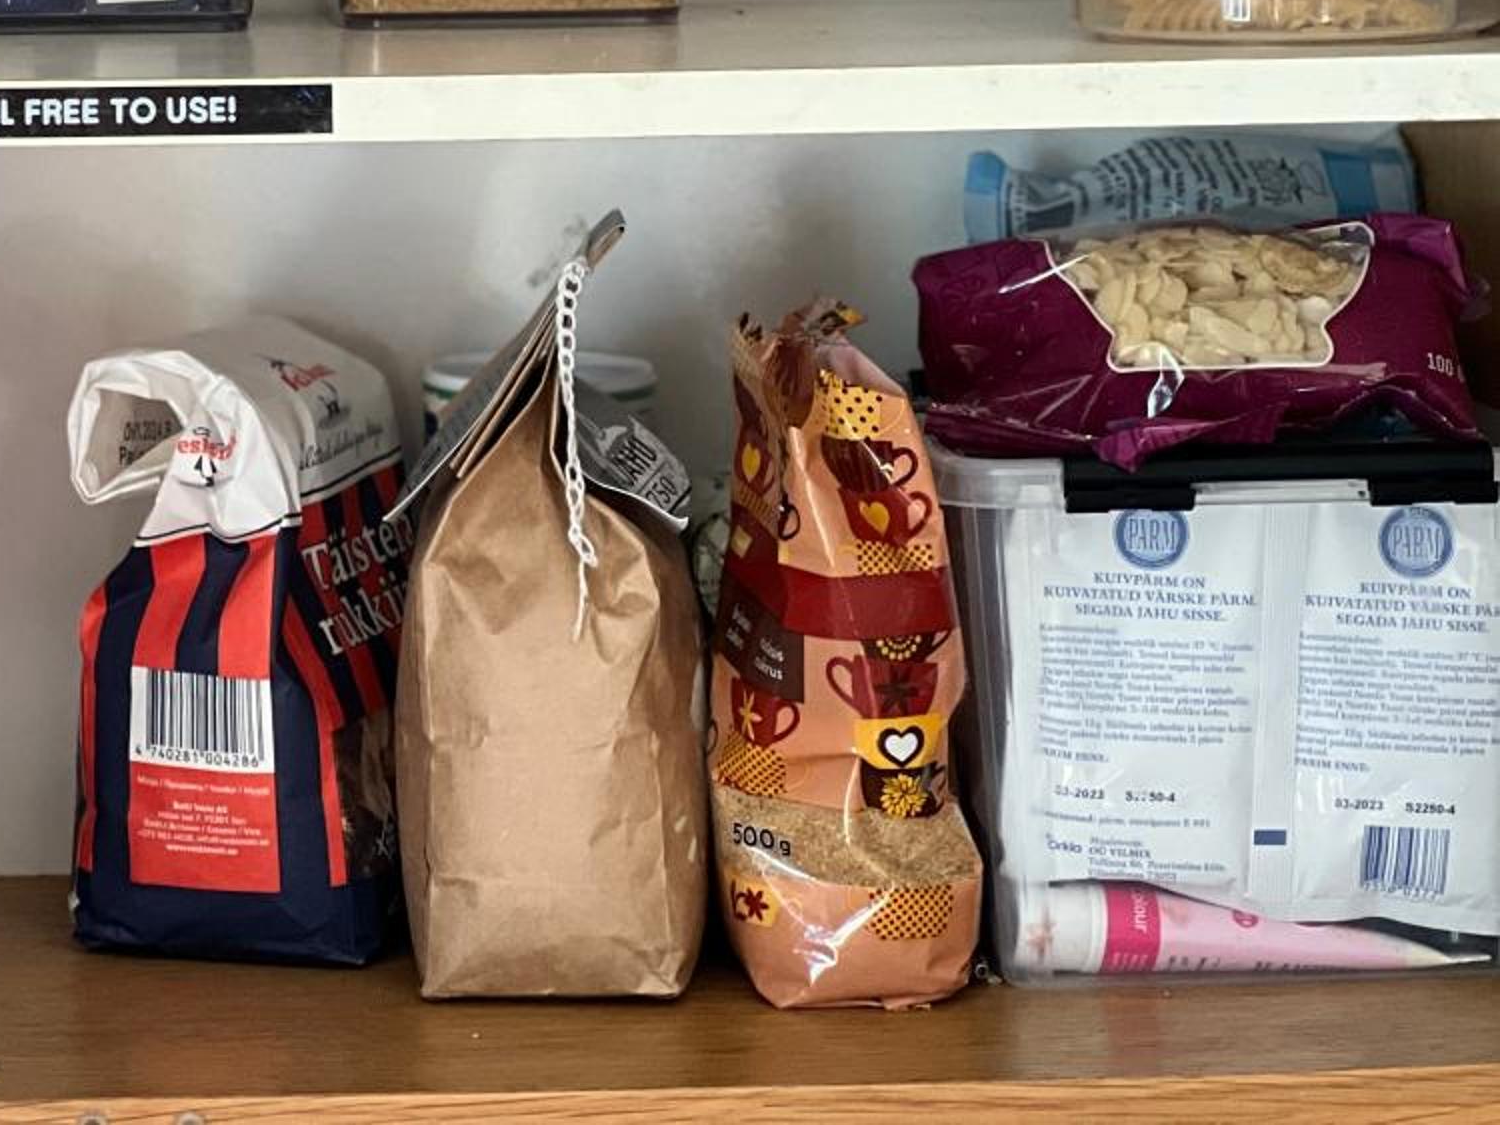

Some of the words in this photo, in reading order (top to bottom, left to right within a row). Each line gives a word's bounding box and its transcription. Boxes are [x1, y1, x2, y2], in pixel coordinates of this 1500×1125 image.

[25, 98, 100, 125] FREE
[110, 98, 157, 124] TO
[167, 96, 237, 123] USE!
[1427, 352, 1453, 376] 100
[1093, 572, 1178, 588] KUIVPÄRM
[1182, 577, 1205, 588] ON
[1044, 586, 1141, 602] KUIVATATUD
[1146, 590, 1207, 606] VÄRSKE
[1447, 586, 1472, 599] ON
[1075, 604, 1134, 619] SEGADA
[1137, 606, 1176, 620] JAHU
[1336, 613, 1397, 629] SEGADA
[1401, 618, 1443, 632] JAHU
[1334, 797, 1385, 811] 03-2023
[733, 822, 774, 849] 500
[780, 839, 791, 857] g
